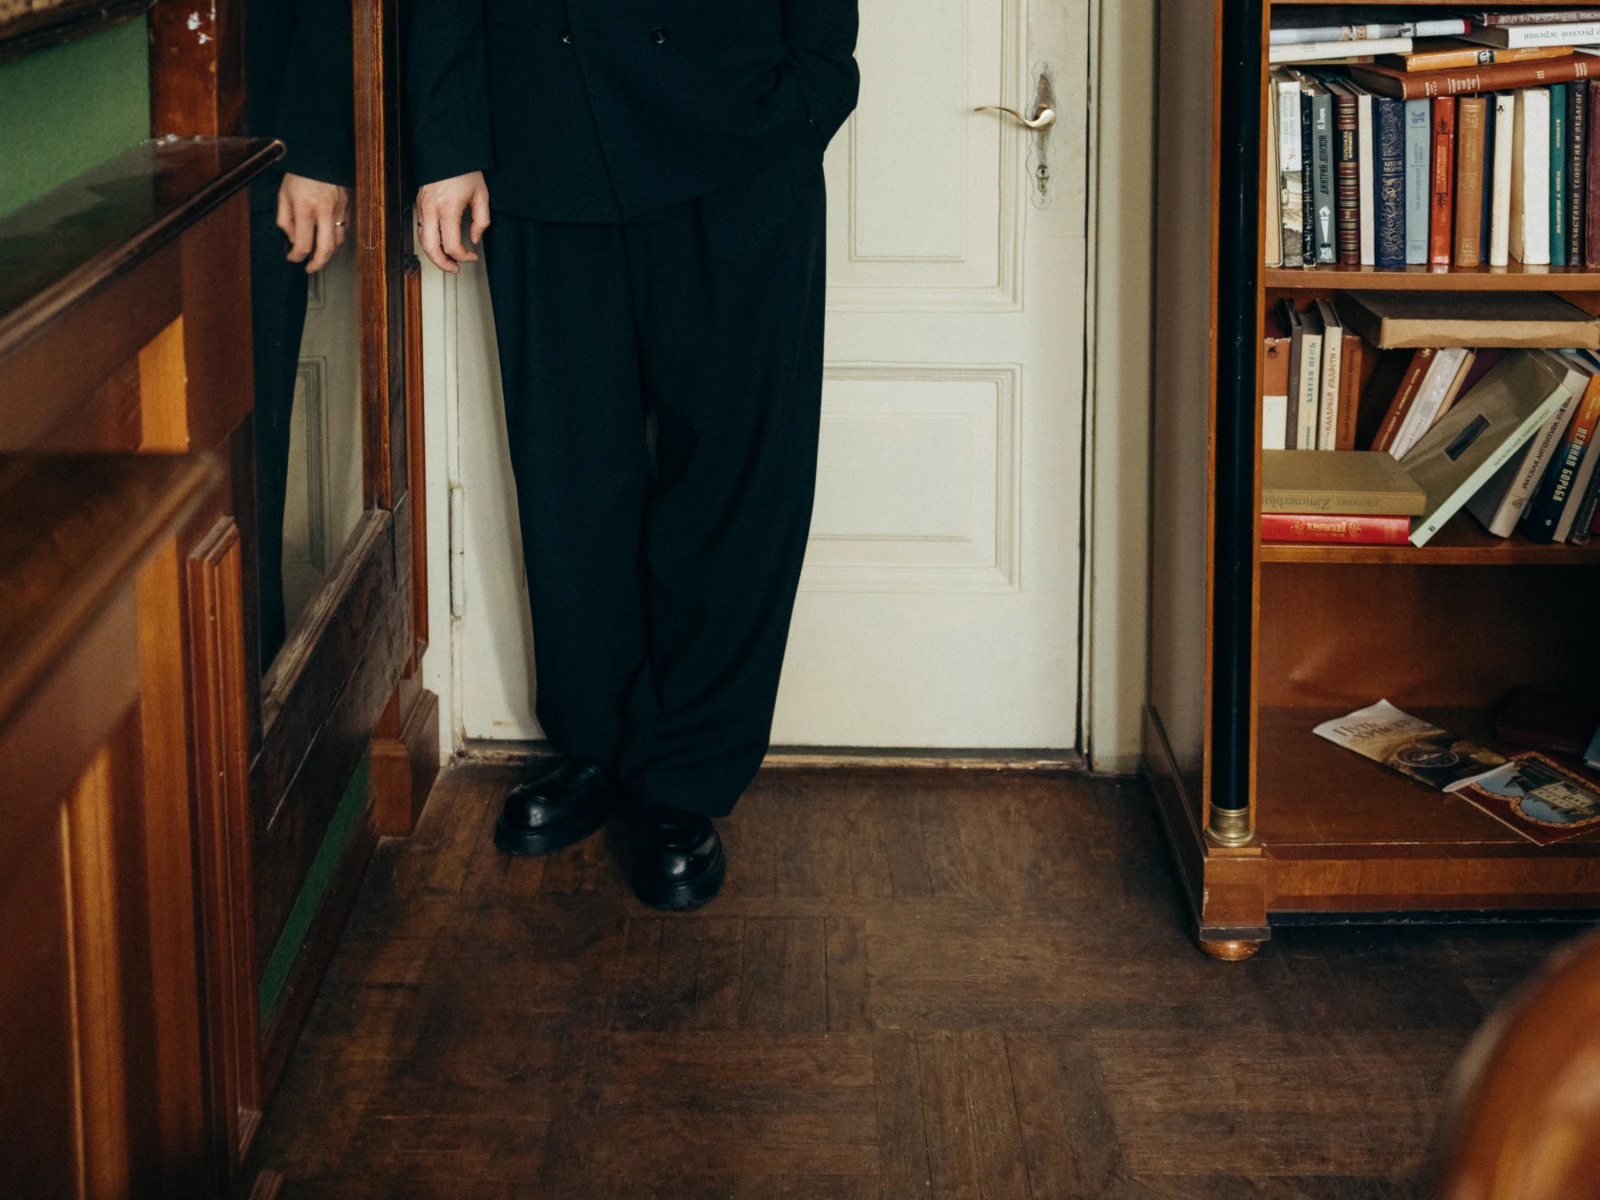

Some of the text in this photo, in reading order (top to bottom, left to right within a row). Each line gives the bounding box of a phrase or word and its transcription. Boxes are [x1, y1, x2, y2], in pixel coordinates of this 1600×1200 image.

[1574, 92, 1583, 132] ПЕДАГОГ
[1318, 135, 1329, 195] ДМИТРИЙ ДОНСКОЙ
[1573, 143, 1581, 189] ТЕОРЕТИК
[1552, 427, 1588, 502] ВЕЛИКАЯ БОРЬБА
